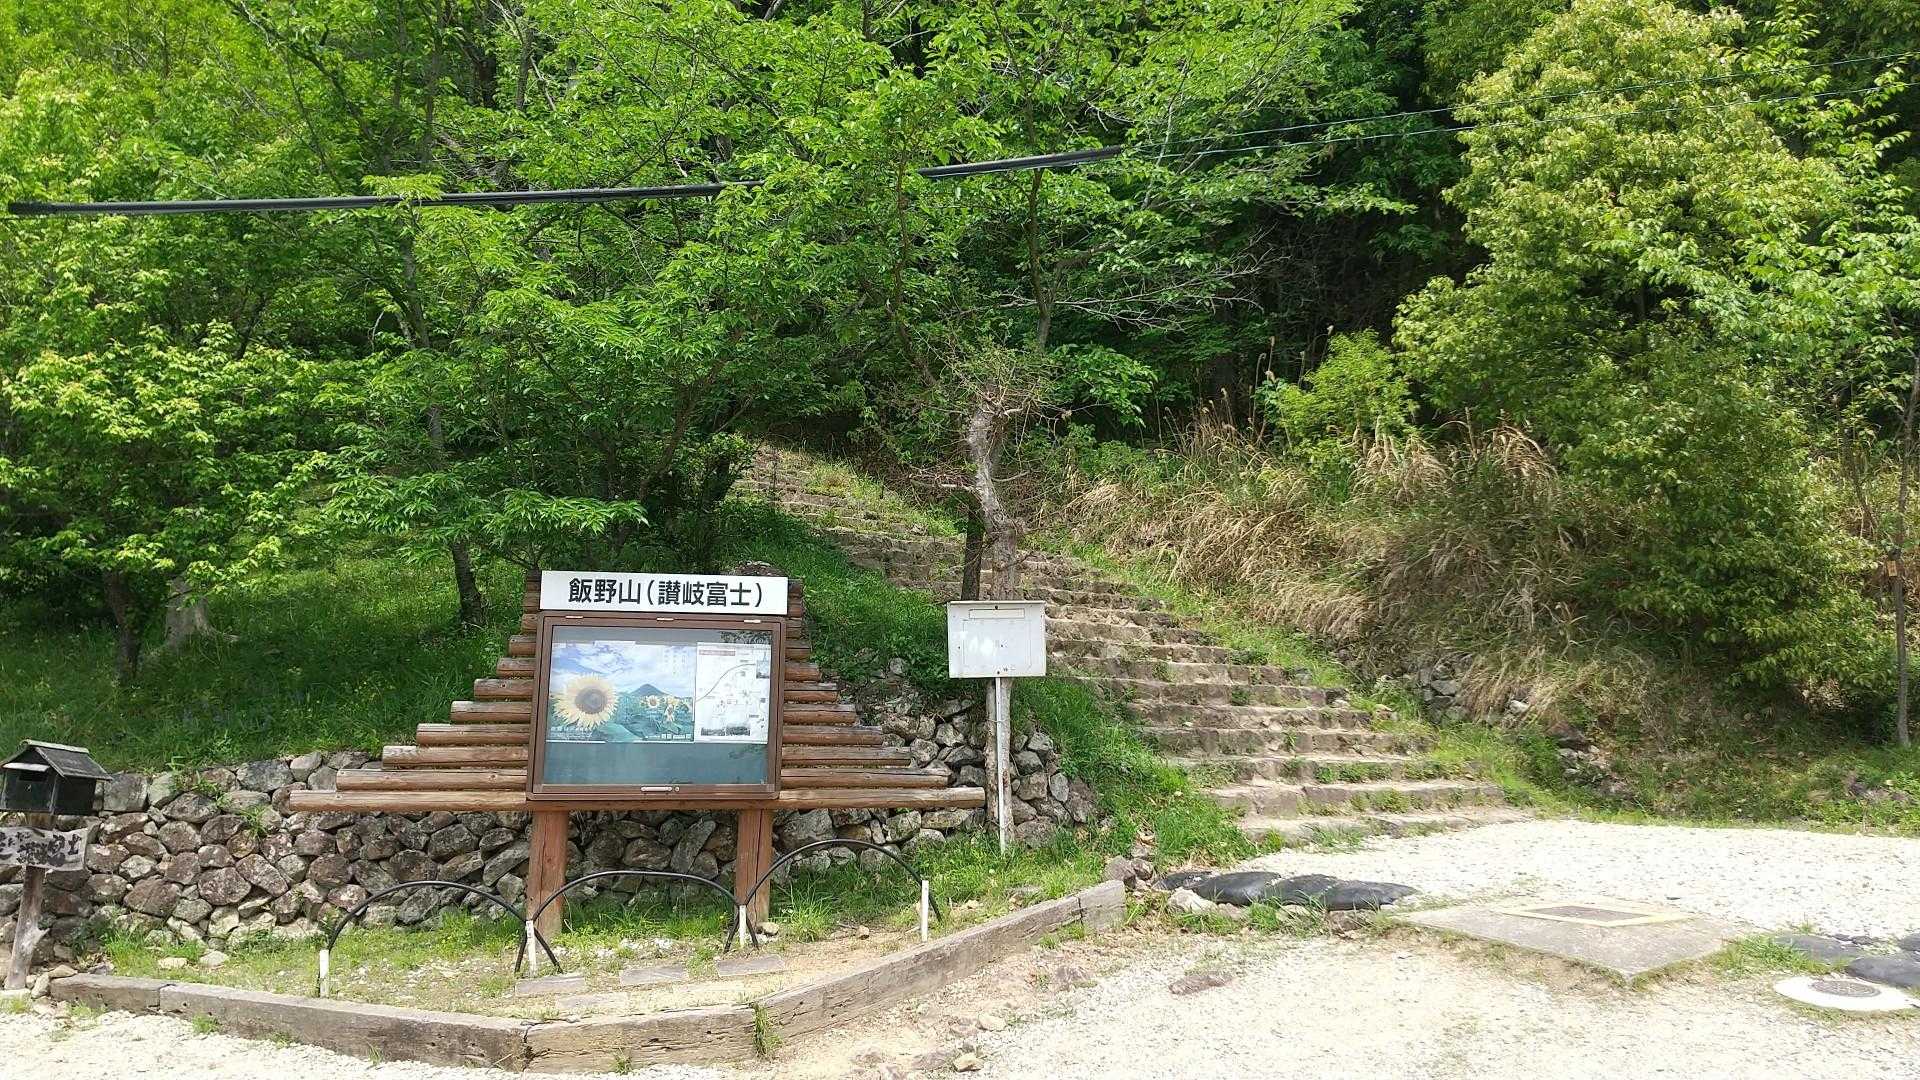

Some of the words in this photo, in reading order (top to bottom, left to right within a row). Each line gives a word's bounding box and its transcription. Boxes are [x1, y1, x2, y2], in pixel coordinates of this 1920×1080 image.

[568, 577, 763, 608] 飯野山(讃岐富士)
